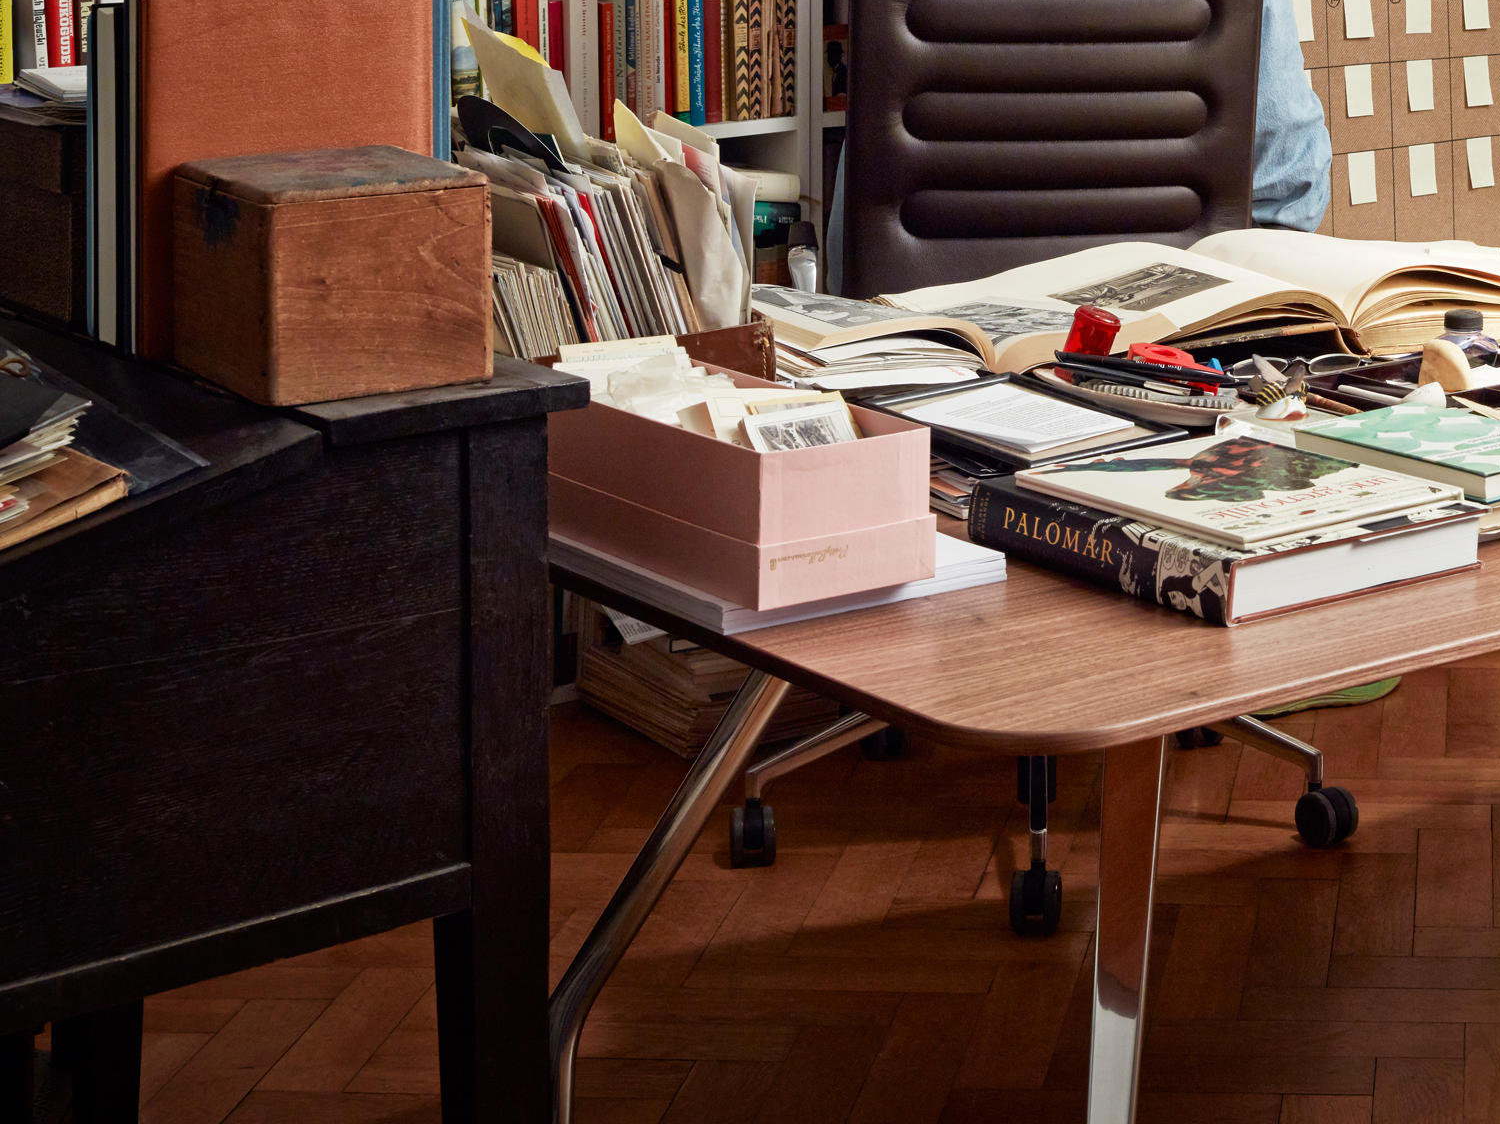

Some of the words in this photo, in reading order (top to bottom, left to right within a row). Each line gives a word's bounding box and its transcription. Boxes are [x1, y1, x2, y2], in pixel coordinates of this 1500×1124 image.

[1344, 475, 1397, 491] une
[1209, 486, 1334, 522] grenouille
[1003, 507, 1116, 566] PALOMAR
